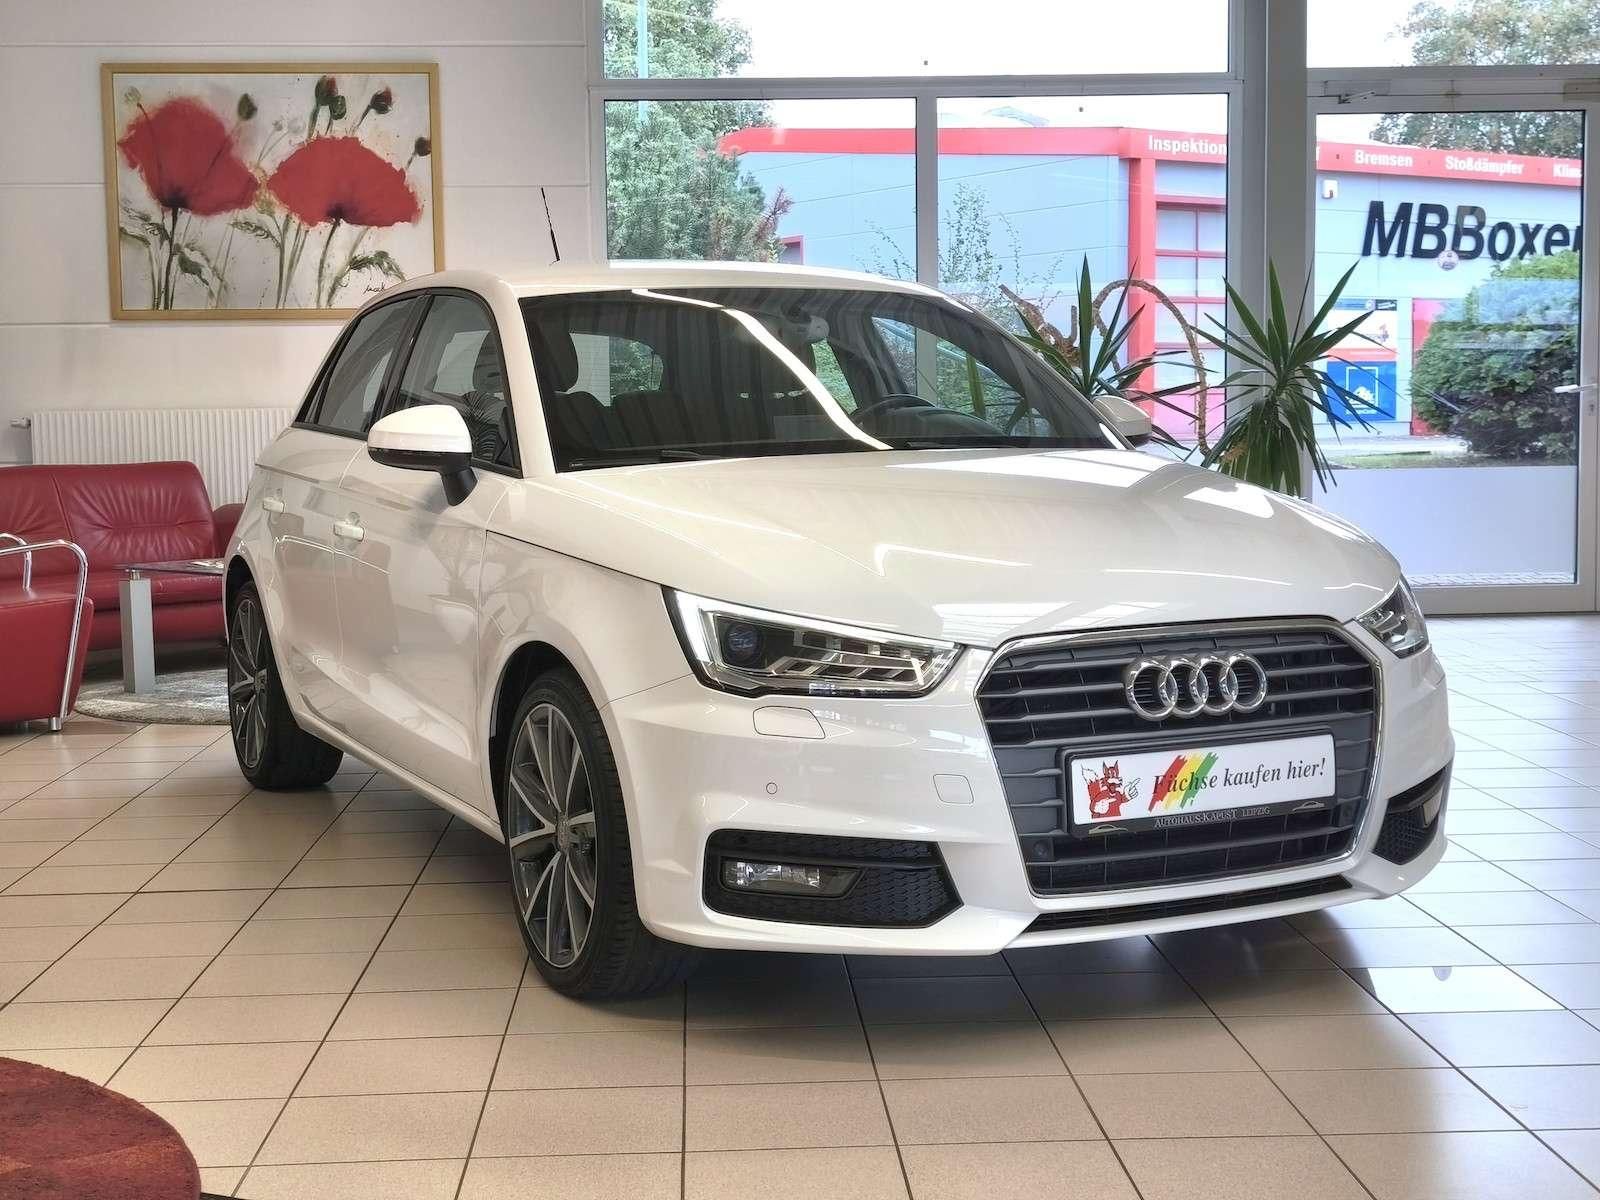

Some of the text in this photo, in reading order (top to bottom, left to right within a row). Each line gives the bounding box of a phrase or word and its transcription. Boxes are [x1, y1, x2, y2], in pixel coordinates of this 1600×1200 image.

[1148, 135, 1228, 156] Inspektion
[1354, 149, 1414, 168] Bremsen
[1445, 156, 1525, 177] Stoßdämpfer
[1153, 758, 1327, 795] Füchse kaufen hier!
[1242, 806, 1271, 818] LEIPZIG
